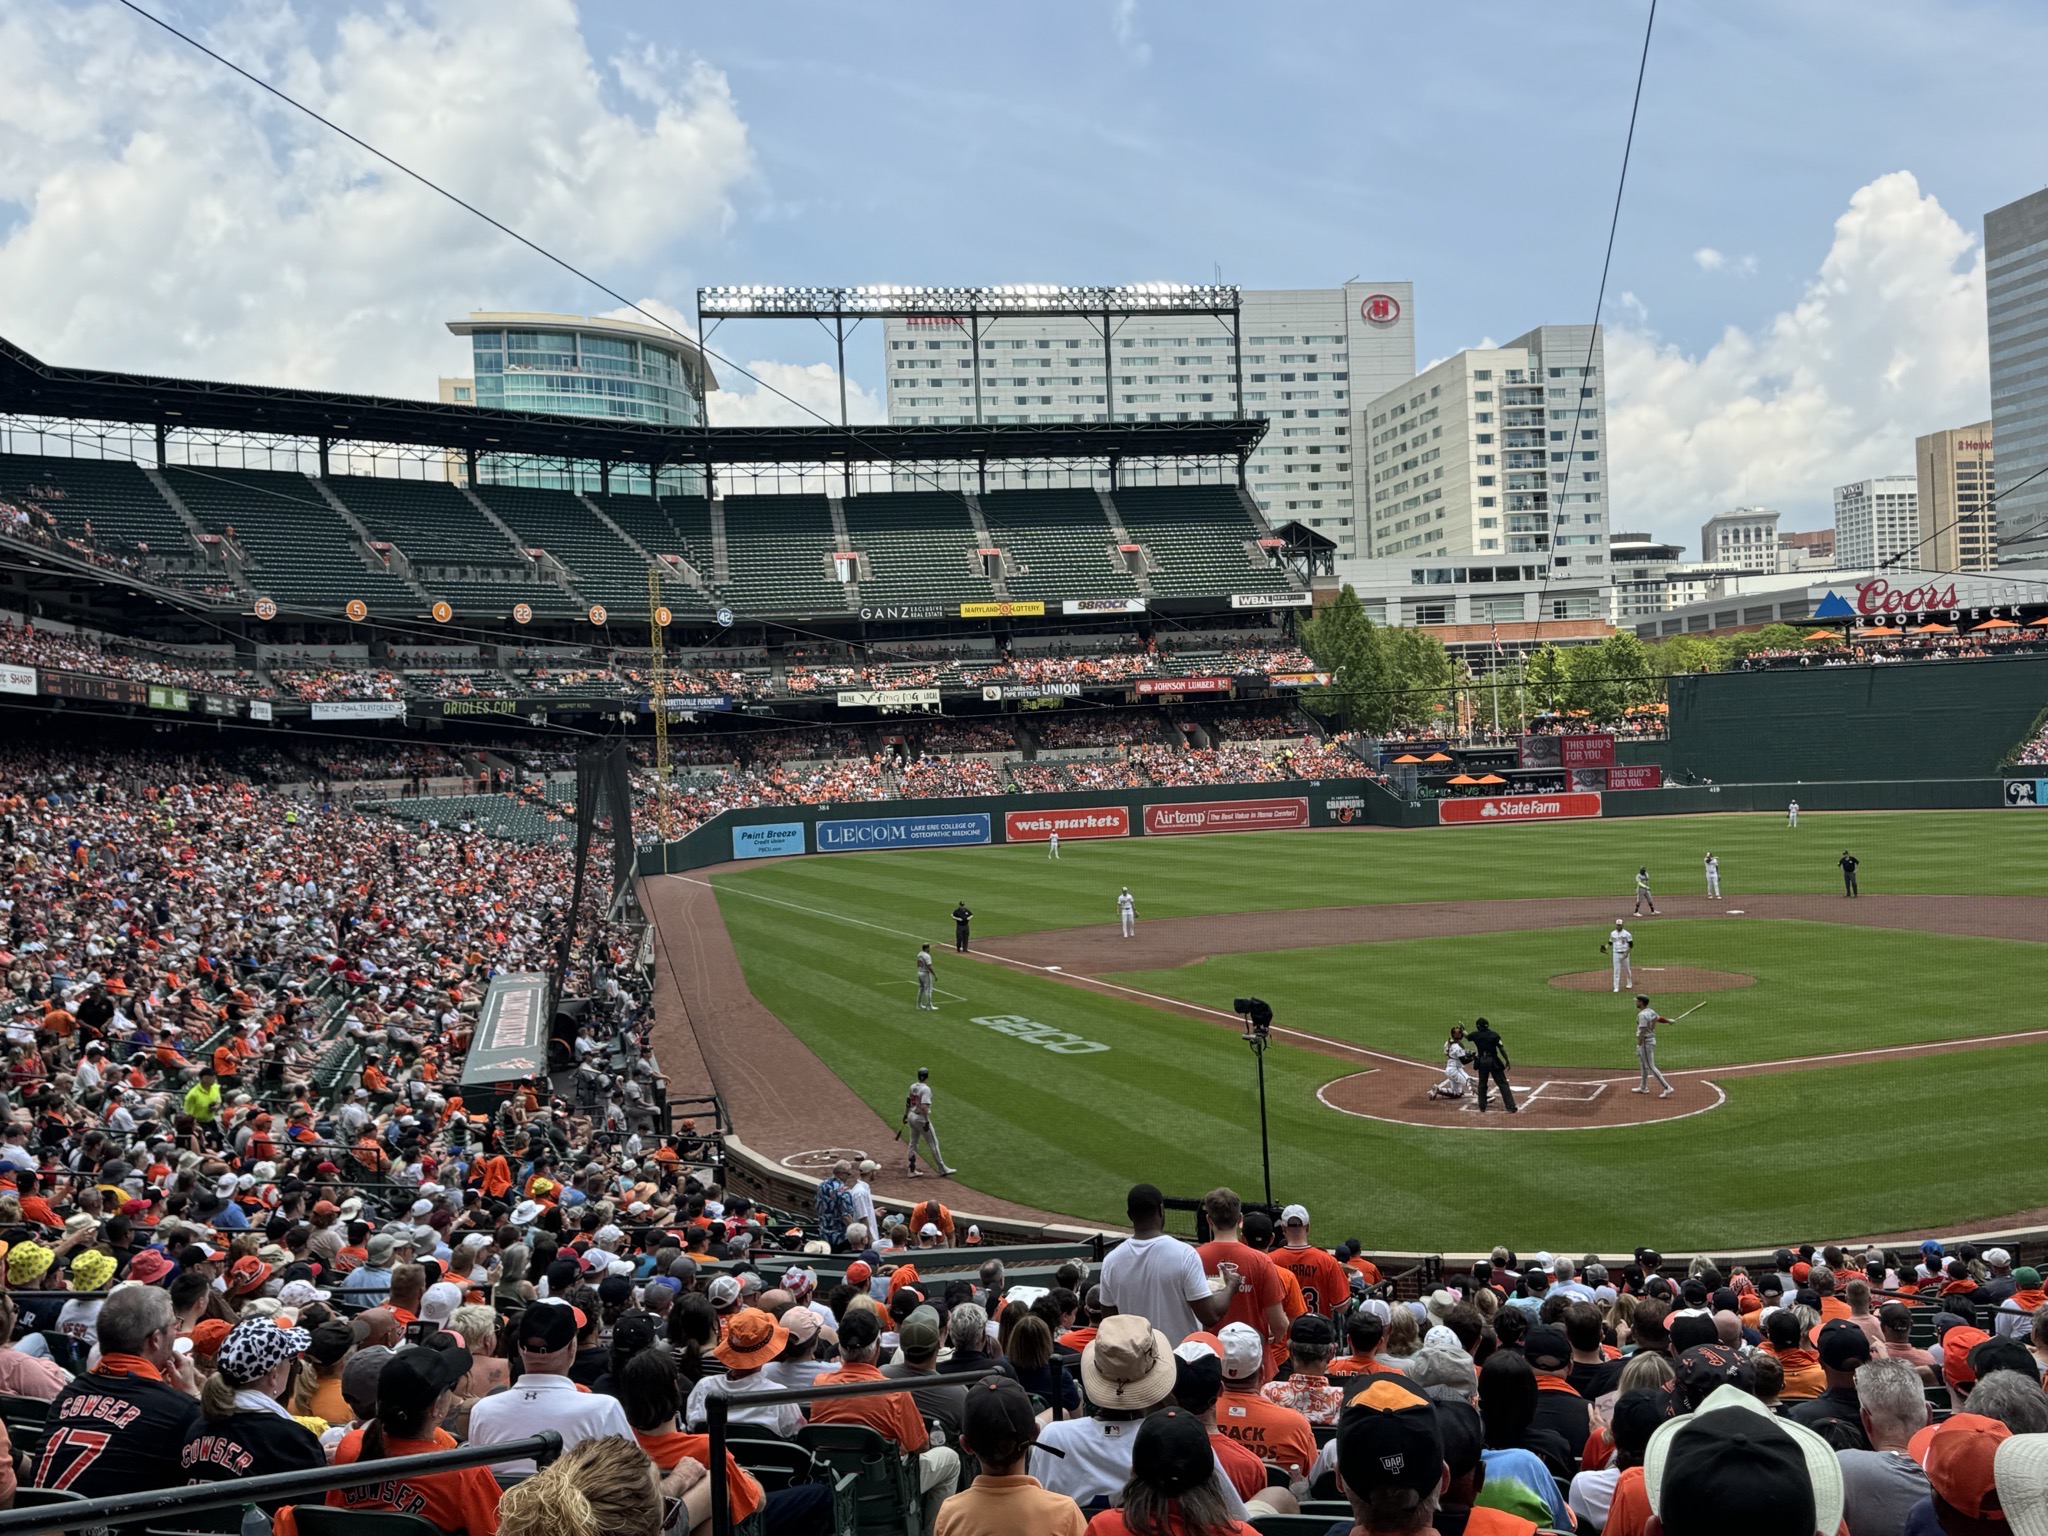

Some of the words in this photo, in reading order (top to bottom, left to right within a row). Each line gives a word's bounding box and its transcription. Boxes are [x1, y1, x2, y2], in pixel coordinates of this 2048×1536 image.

[1240, 595, 1273, 605] WBAL
[1856, 579, 1960, 615] Coors
[258, 603, 274, 615] 20
[352, 604, 361, 616] 5
[1078, 600, 1128, 610] 98ROCK
[438, 606, 445, 618] 4
[516, 608, 529, 619] 22
[592, 609, 606, 621] 33
[660, 611, 667, 621] 8
[720, 612, 731, 622] 42
[860, 606, 909, 619] GANZ
[1856, 612, 1925, 628] ROOF
[1951, 605, 2021, 621] DECK
[10, 673, 32, 685] SHARP
[1041, 683, 1080, 696] UNION
[1154, 681, 1186, 691] JOHNSON
[1187, 680, 1215, 690] LUMBER
[923, 691, 938, 700] LOCAL
[443, 701, 516, 714] ORIOLES.COM
[1565, 740, 1585, 750] THIS
[1586, 739, 1612, 749] BUD'S
[1566, 750, 1582, 760] FOR
[1583, 750, 1604, 760] YOU.
[1611, 770, 1628, 778] THIS
[1628, 769, 1651, 778] BUD'S
[1611, 779, 1626, 787] FOR
[1326, 799, 1365, 809] CHAMPIONS
[1015, 818, 1052, 831] weis
[1054, 815, 1120, 829] markets
[1155, 810, 1206, 827] Airtemp
[767, 830, 797, 838] Breeze
[911, 831, 951, 839] OSTEOPATHIC
[951, 829, 981, 837] MEDICINE
[640, 846, 653, 854] 333
[59, 1395, 141, 1429] COWSER
[1217, 1424, 1265, 1441] BACK
[33, 1426, 112, 1491] 17
[181, 1436, 253, 1476] COWSER
